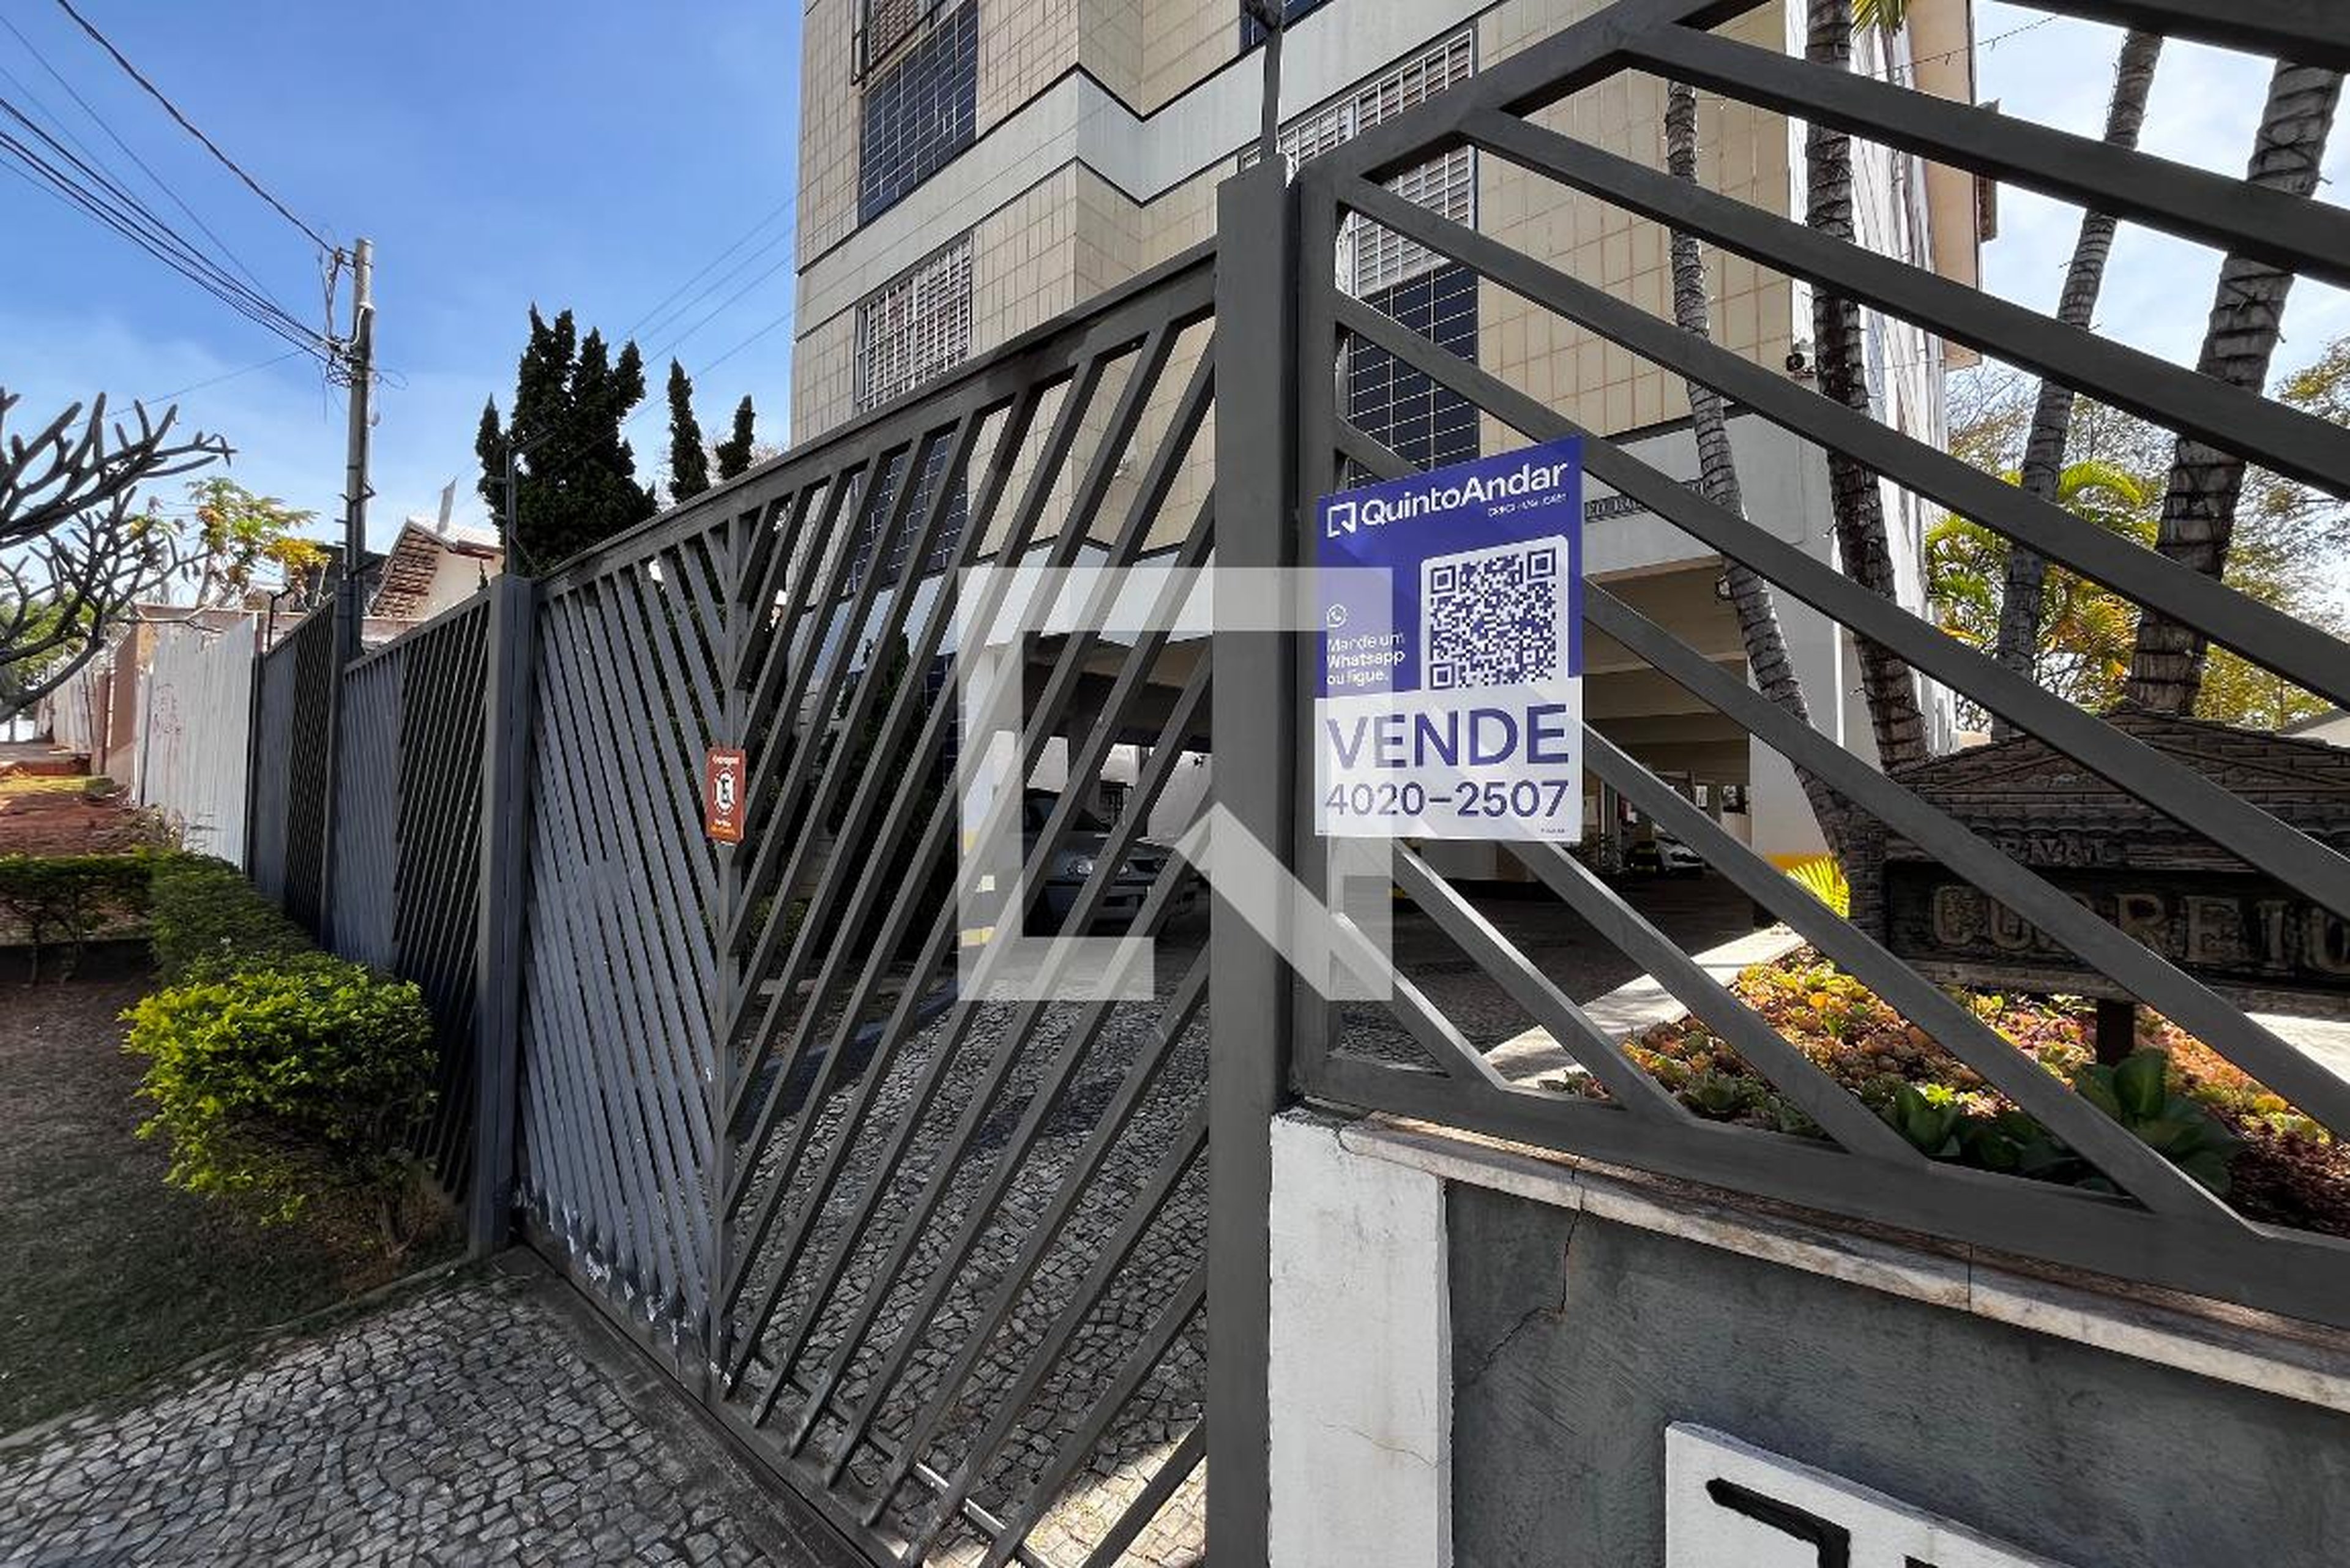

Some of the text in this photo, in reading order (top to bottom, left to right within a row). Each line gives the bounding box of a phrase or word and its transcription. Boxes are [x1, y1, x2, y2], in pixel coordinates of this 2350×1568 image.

[1361, 461, 1569, 529] QuintoAndar
[1379, 632, 1406, 647] um
[1327, 650, 1406, 669] Whatsapp
[1326, 673, 1345, 685] ou
[1327, 704, 1569, 770] VENDE
[1325, 779, 1569, 818] 4020-2507
